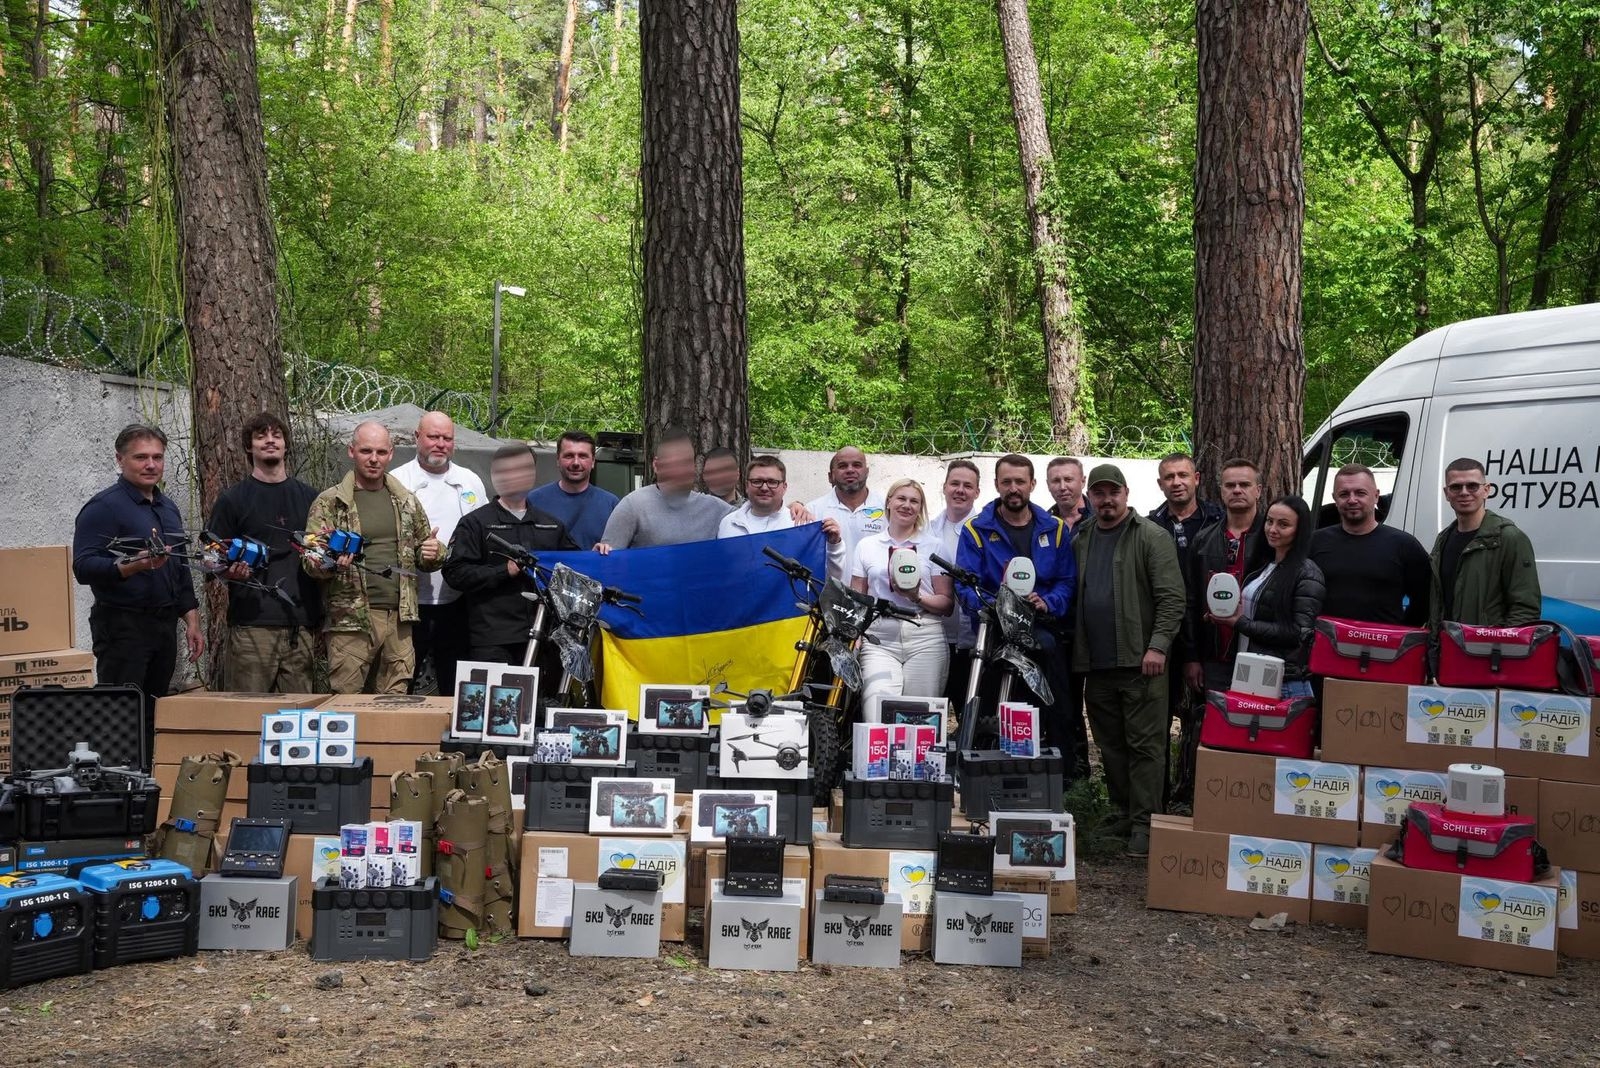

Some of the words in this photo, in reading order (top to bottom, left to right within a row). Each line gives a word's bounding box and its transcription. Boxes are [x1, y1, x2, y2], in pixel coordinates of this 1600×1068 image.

[1485, 447, 1583, 476] НАША
[1348, 630, 1388, 642] SCHILLER
[1475, 628, 1519, 638] SCHILLER
[31, 659, 59, 668] ТІНЬ
[1237, 701, 1276, 711] SCHILLER
[1448, 707, 1486, 718] НАДІЯ
[1540, 713, 1580, 726] НАДІЯ
[1012, 726, 1031, 736] 15C
[870, 746, 888, 754] 15C
[1313, 780, 1350, 792] НАДІЯ
[1404, 788, 1442, 801] НАДІЯ
[1442, 822, 1487, 836] SCHILLER
[638, 860, 676, 871] НАДІЯ
[1265, 857, 1302, 869] НАДІЯ
[145, 880, 170, 888] 1200-1
[171, 878, 178, 886] Q
[20, 898, 34, 907] ISG
[36, 894, 61, 904] 1200-1
[62, 892, 70, 900] Q
[208, 904, 228, 918] SKY
[256, 906, 280, 918] RAGE
[1504, 902, 1546, 917] НАДІЯ
[585, 910, 604, 924] SKY
[630, 913, 654, 926] RAGE
[722, 924, 740, 938] SKY
[767, 926, 792, 940] RAGE
[824, 922, 842, 934] SKY
[869, 924, 892, 936] RAGE
[946, 918, 964, 930] SKY
[990, 920, 1014, 934] RAGE
